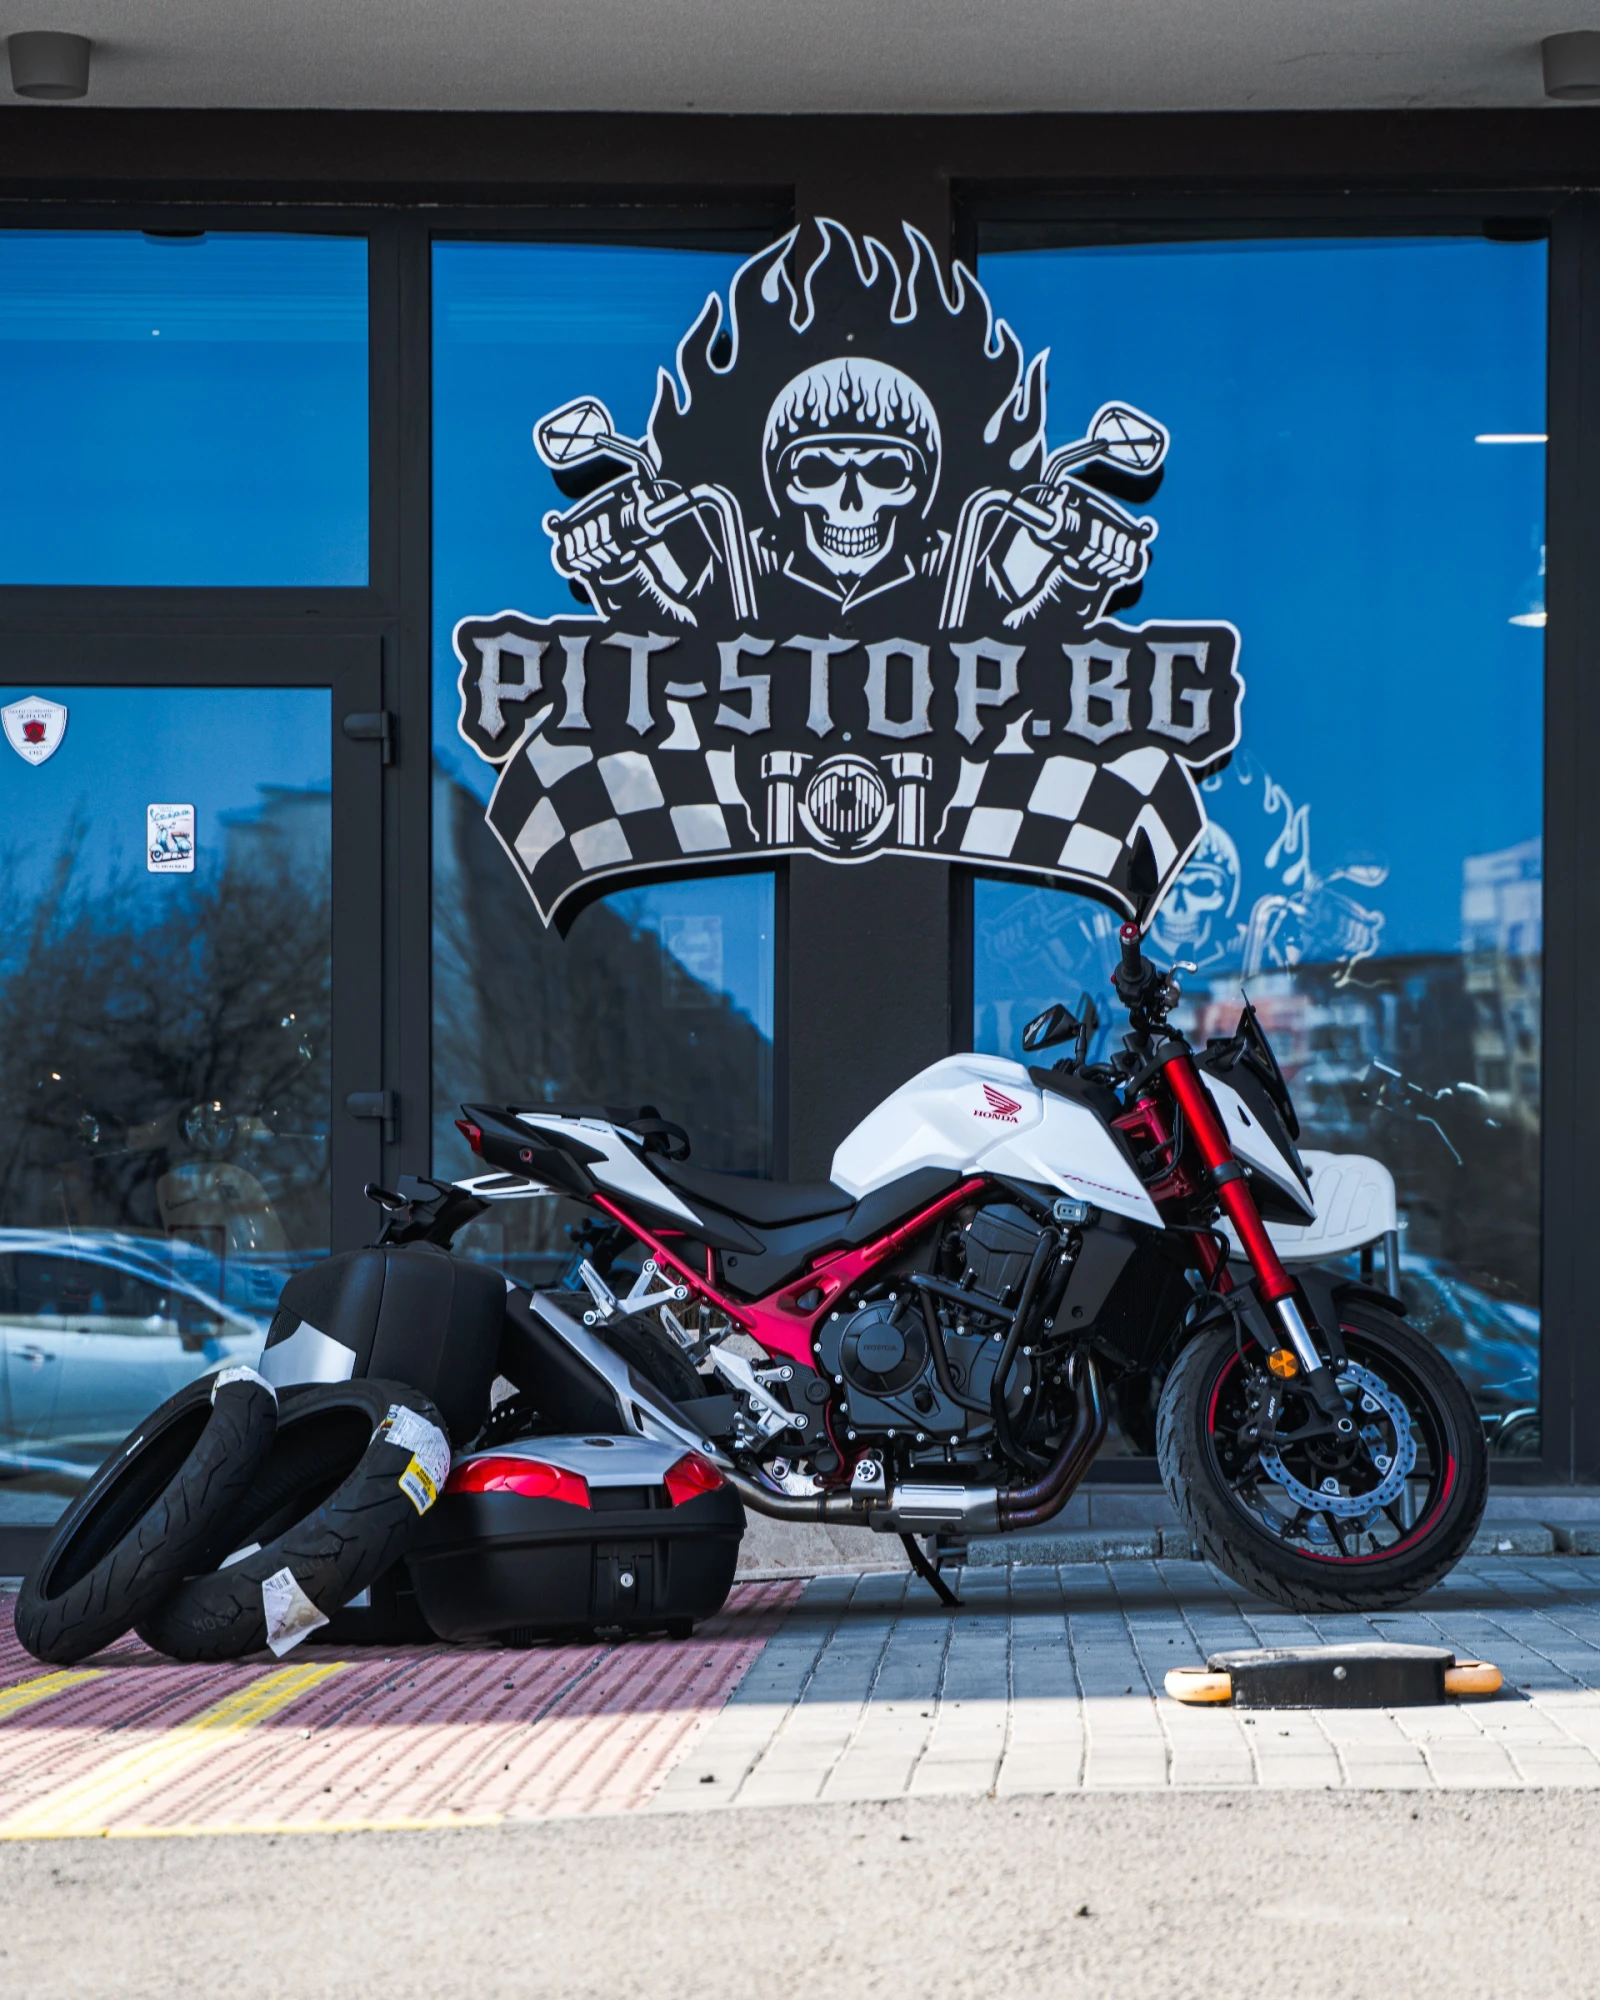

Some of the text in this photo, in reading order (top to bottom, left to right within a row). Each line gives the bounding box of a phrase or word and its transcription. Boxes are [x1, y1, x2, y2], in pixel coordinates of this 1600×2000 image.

[472, 632, 1213, 745] PIT-STOP.BG
[973, 1109, 1018, 1124] HONDA
[863, 1344, 899, 1352] HONDA
